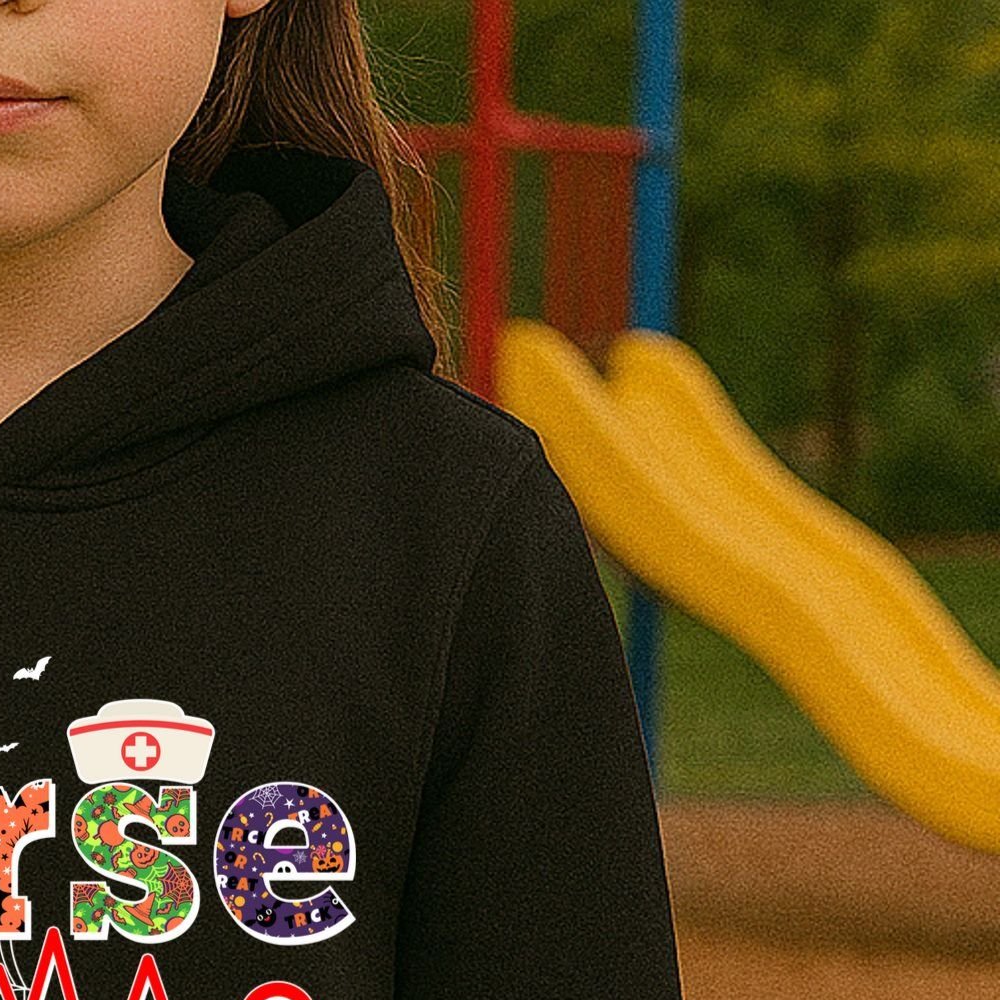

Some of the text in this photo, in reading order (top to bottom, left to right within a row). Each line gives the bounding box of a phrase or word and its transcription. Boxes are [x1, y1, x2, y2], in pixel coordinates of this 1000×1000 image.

[296, 785, 320, 799] OR
[224, 851, 248, 870] OR
[284, 906, 332, 929] TRICK
